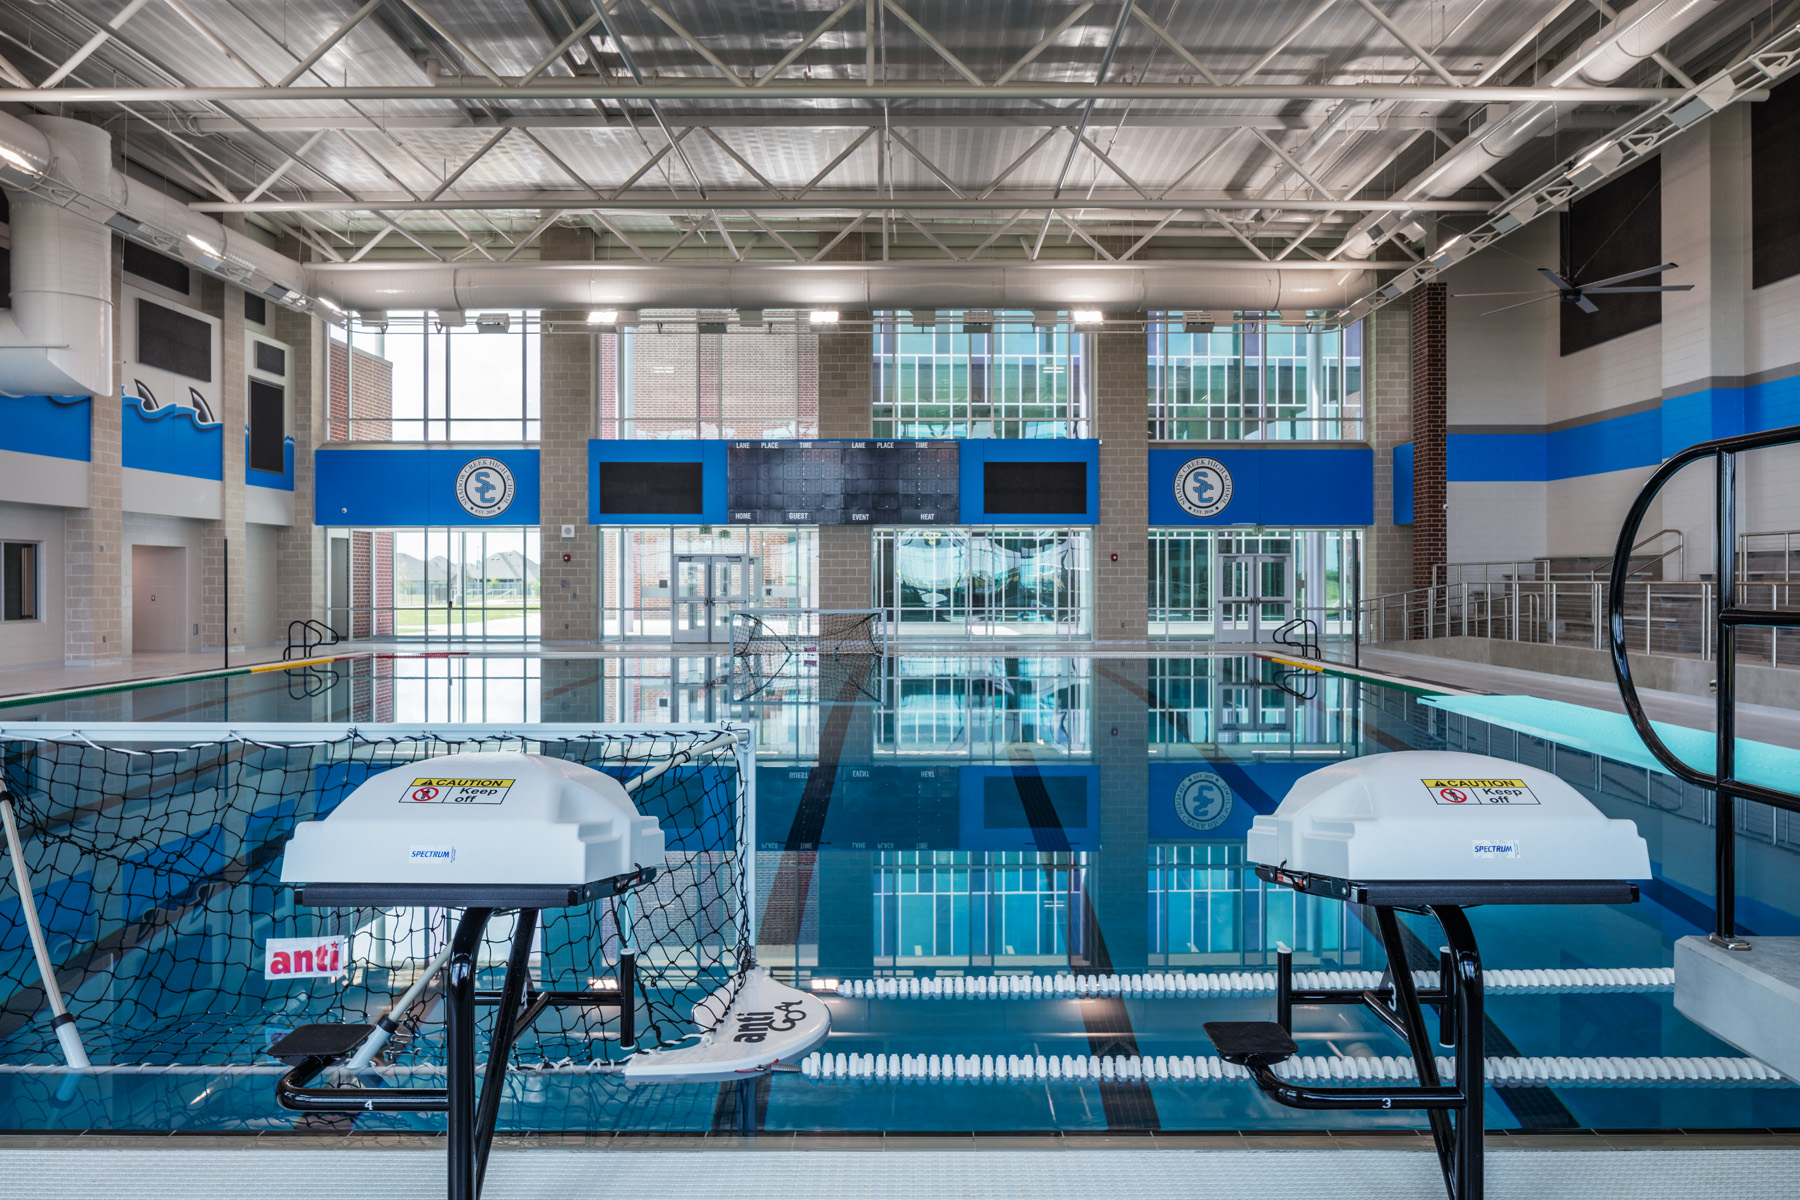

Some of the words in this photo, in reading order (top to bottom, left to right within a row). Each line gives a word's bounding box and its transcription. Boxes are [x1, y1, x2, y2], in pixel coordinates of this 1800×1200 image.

[457, 473, 468, 506] SHADOW
[464, 459, 488, 474] CREEK
[489, 460, 508, 475] HIGH
[502, 474, 513, 504] SCHOOL
[1175, 473, 1186, 506] SHADOW
[1182, 459, 1206, 473] CREEK
[1207, 460, 1226, 475] HIGH
[1220, 474, 1231, 504] SCHOOL
[735, 512, 751, 520] HOME
[788, 512, 808, 520] GUEST
[436, 779, 504, 787] CAUTION
[460, 787, 498, 796] Keep
[1482, 788, 1523, 797] Keep
[454, 795, 477, 803] off
[1489, 796, 1510, 804] off
[1474, 845, 1513, 853] SPECTRUM
[410, 850, 450, 858] SPECTRUM
[270, 941, 339, 974] anti
[521, 982, 528, 1010] 4
[1387, 981, 1397, 1012] 3
[733, 1011, 774, 1043] anti
[364, 1099, 373, 1110] 4
[1382, 1097, 1391, 1109] 3
